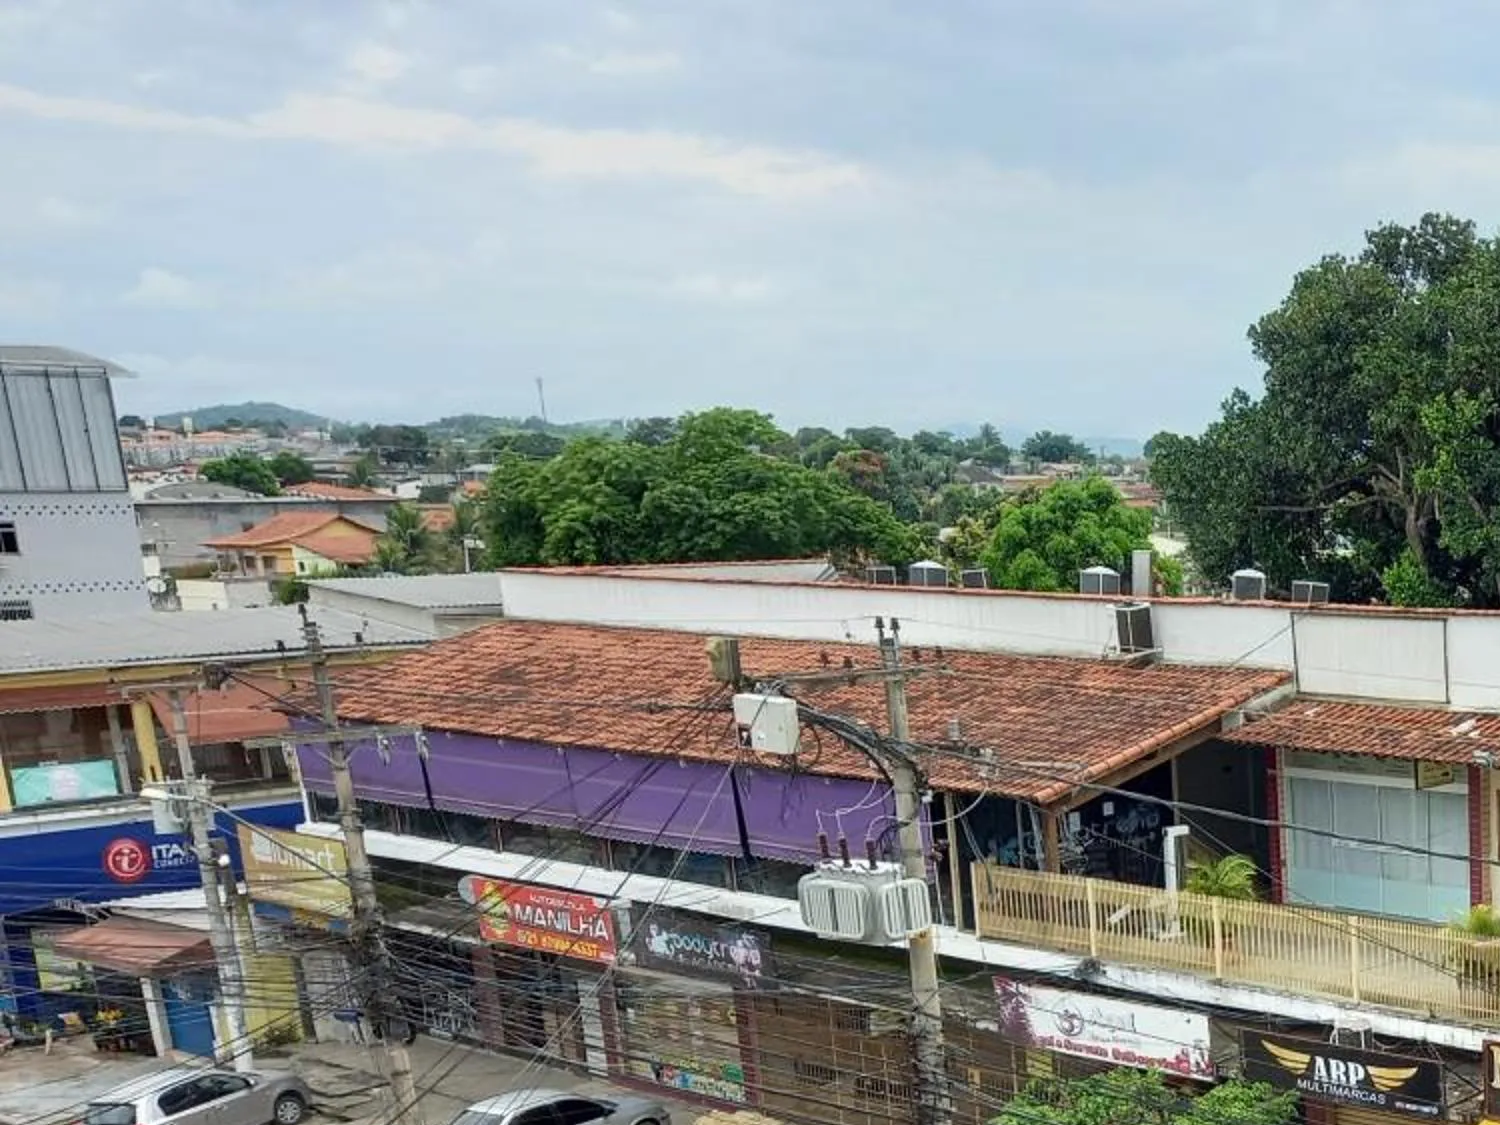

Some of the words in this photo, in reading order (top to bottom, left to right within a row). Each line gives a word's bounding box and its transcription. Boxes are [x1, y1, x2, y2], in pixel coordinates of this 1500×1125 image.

[514, 903, 609, 941] MANILHA
[1313, 1055, 1365, 1087] ARP
[1296, 1078, 1386, 1105] MULTIMARCAS
